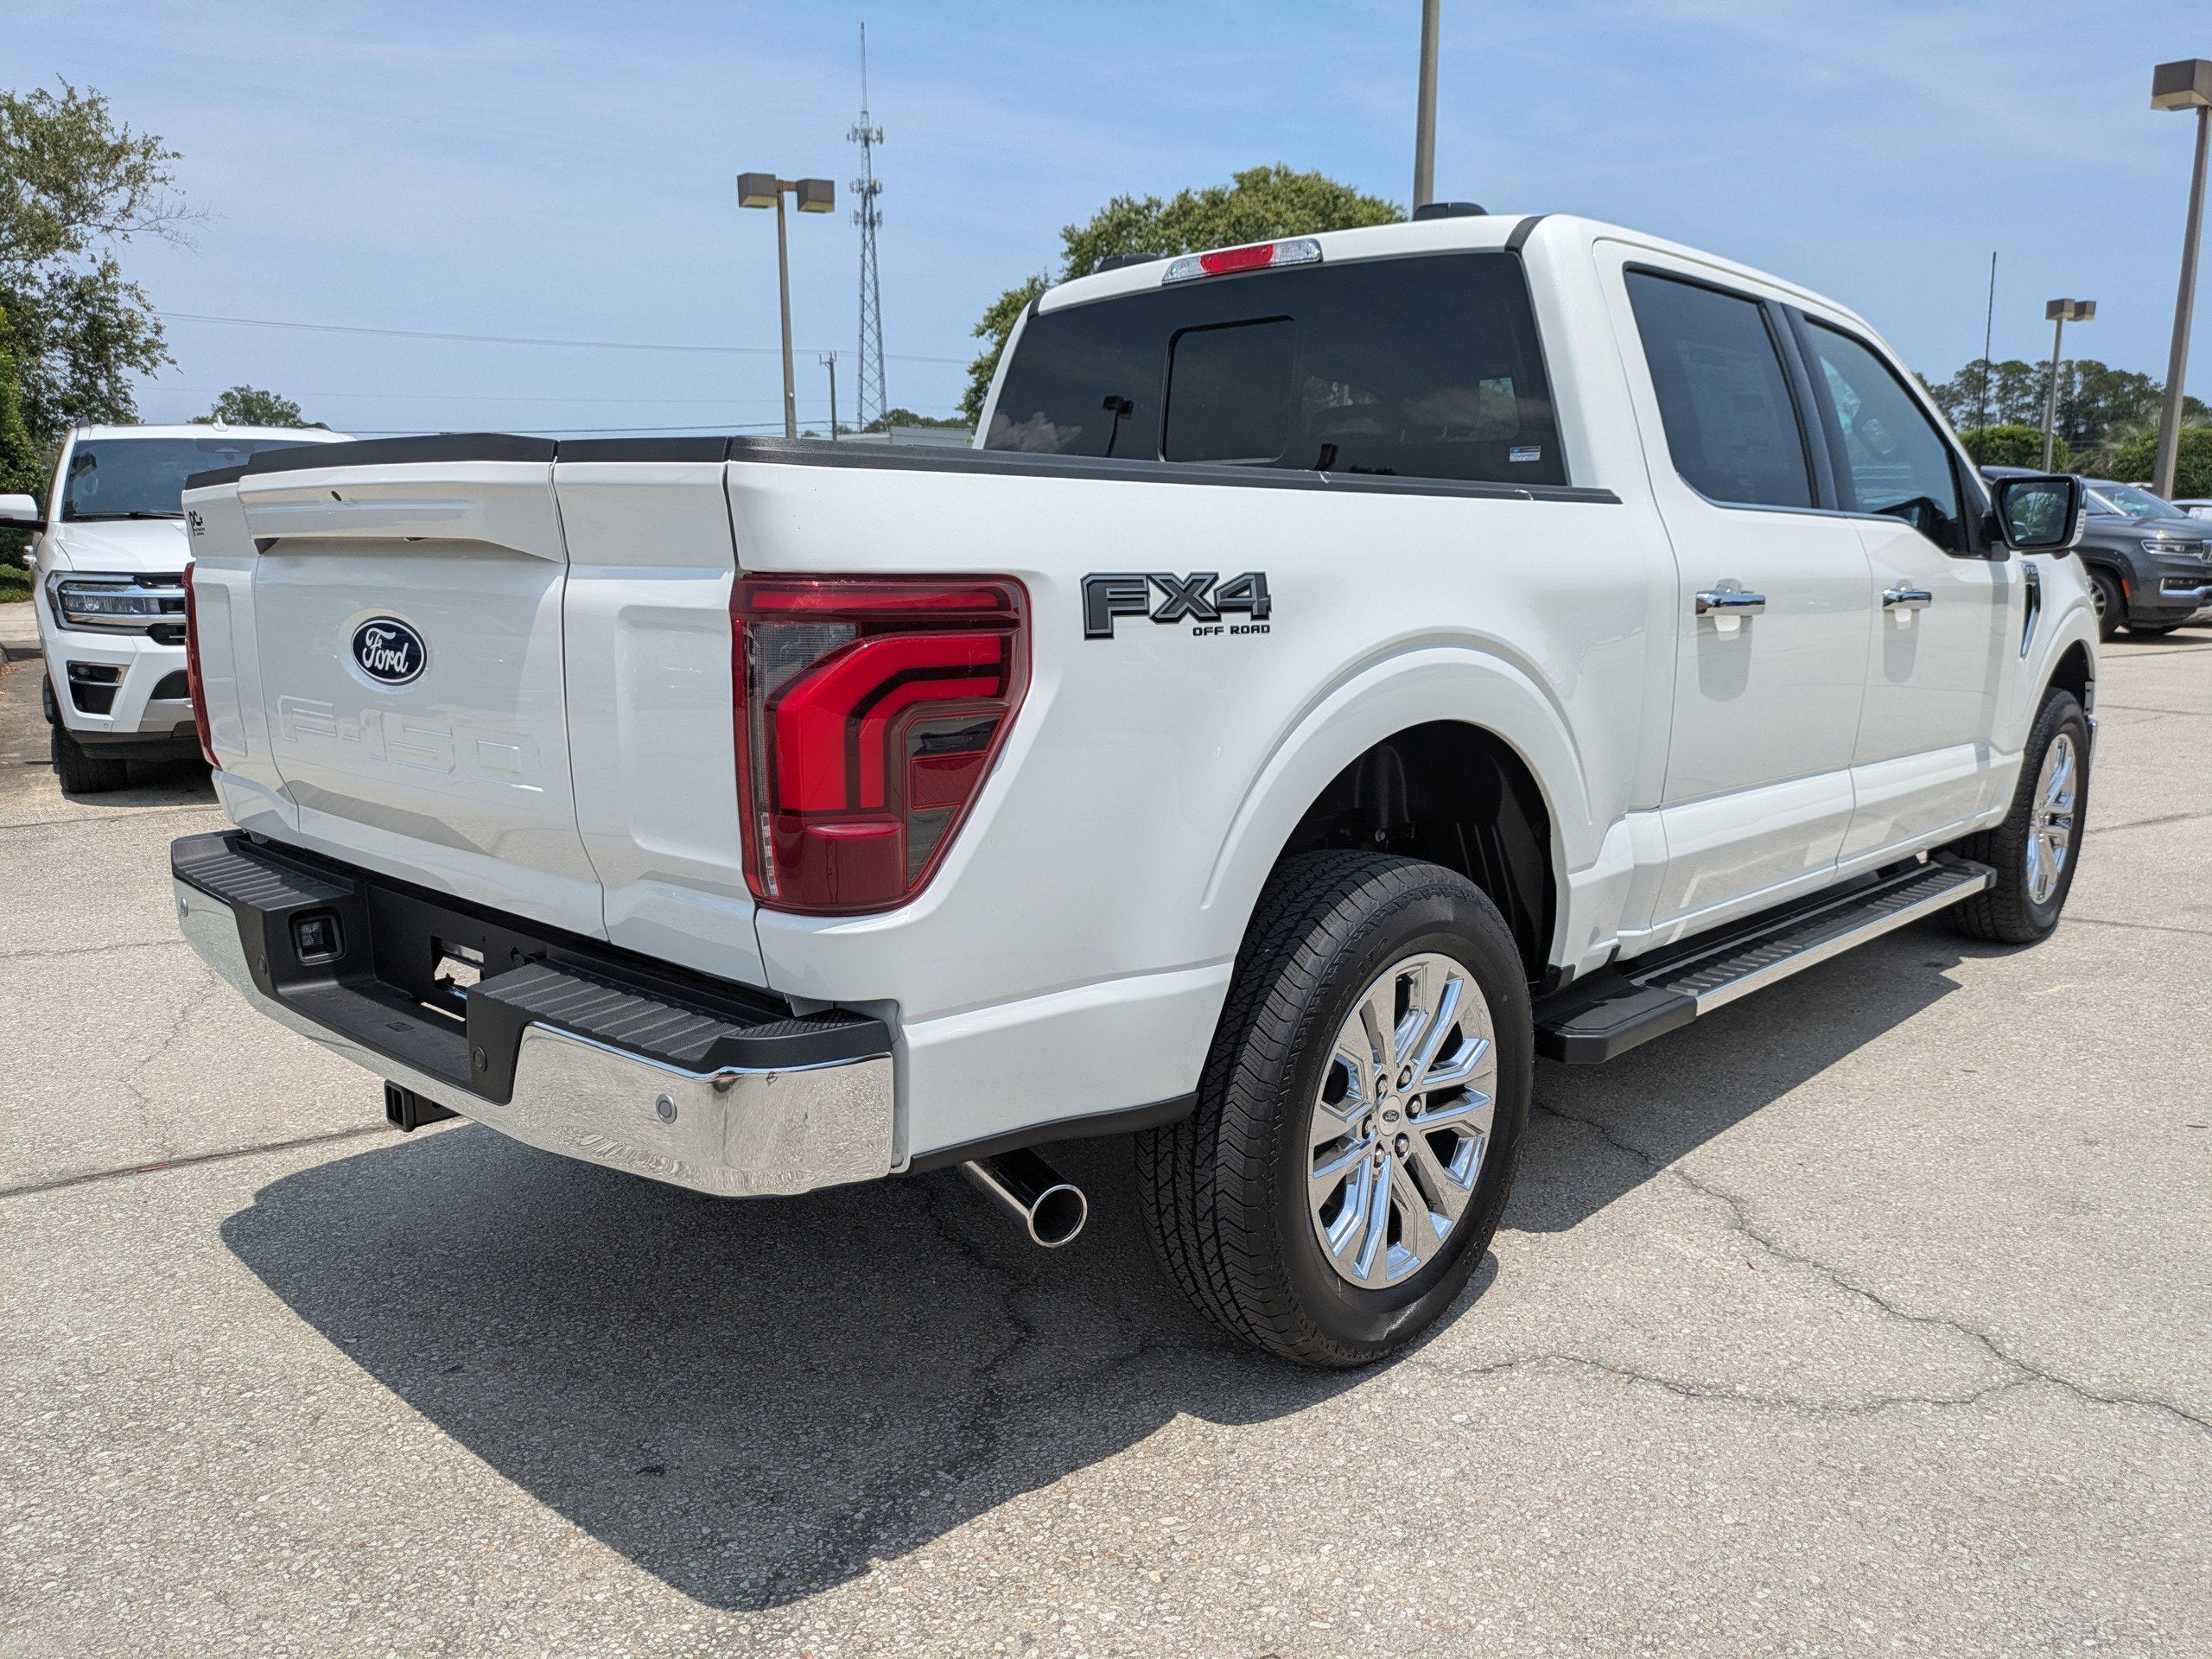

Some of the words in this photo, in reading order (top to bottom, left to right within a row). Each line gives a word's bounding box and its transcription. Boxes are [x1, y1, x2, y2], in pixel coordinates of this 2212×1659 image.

[1080, 571, 1272, 641] FX4
[1192, 626, 1224, 636] OFF
[1230, 624, 1271, 635] ROAD
[362, 627, 409, 673] Ford
[276, 694, 543, 793] F-150
